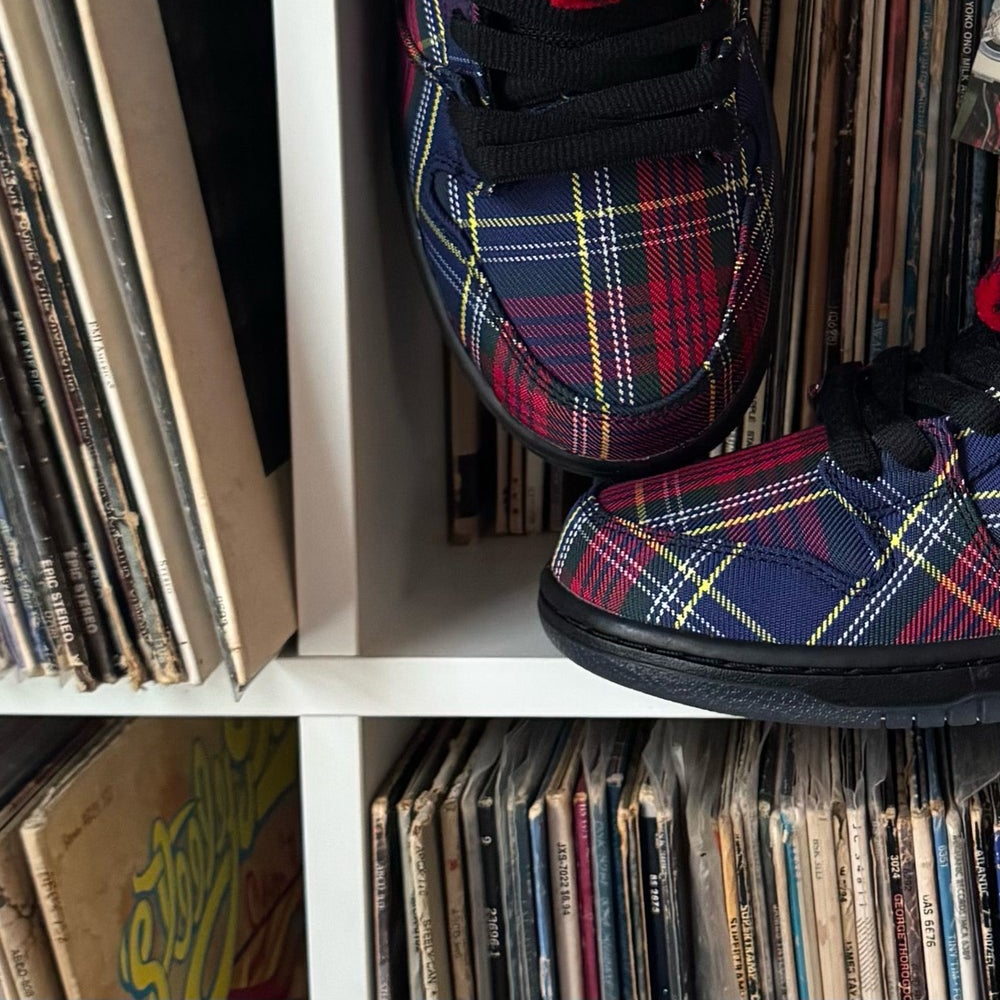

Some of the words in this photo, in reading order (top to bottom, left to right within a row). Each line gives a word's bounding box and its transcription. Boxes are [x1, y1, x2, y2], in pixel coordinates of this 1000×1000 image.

[964, 1, 974, 30] YOKO
[962, 32, 972, 54] ONO
[960, 57, 970, 82] MILK
[65, 550, 85, 581] EPIC
[39, 559, 59, 589] EPIC
[50, 592, 74, 642] STEREO
[72, 583, 98, 634] STEREO
[482, 836, 492, 844] 9
[556, 842, 569, 887] JXS-7022
[890, 854, 900, 879] 3024
[893, 894, 906, 939] GEORGE
[938, 845, 947, 868] 6351
[947, 935, 957, 959] TINY
